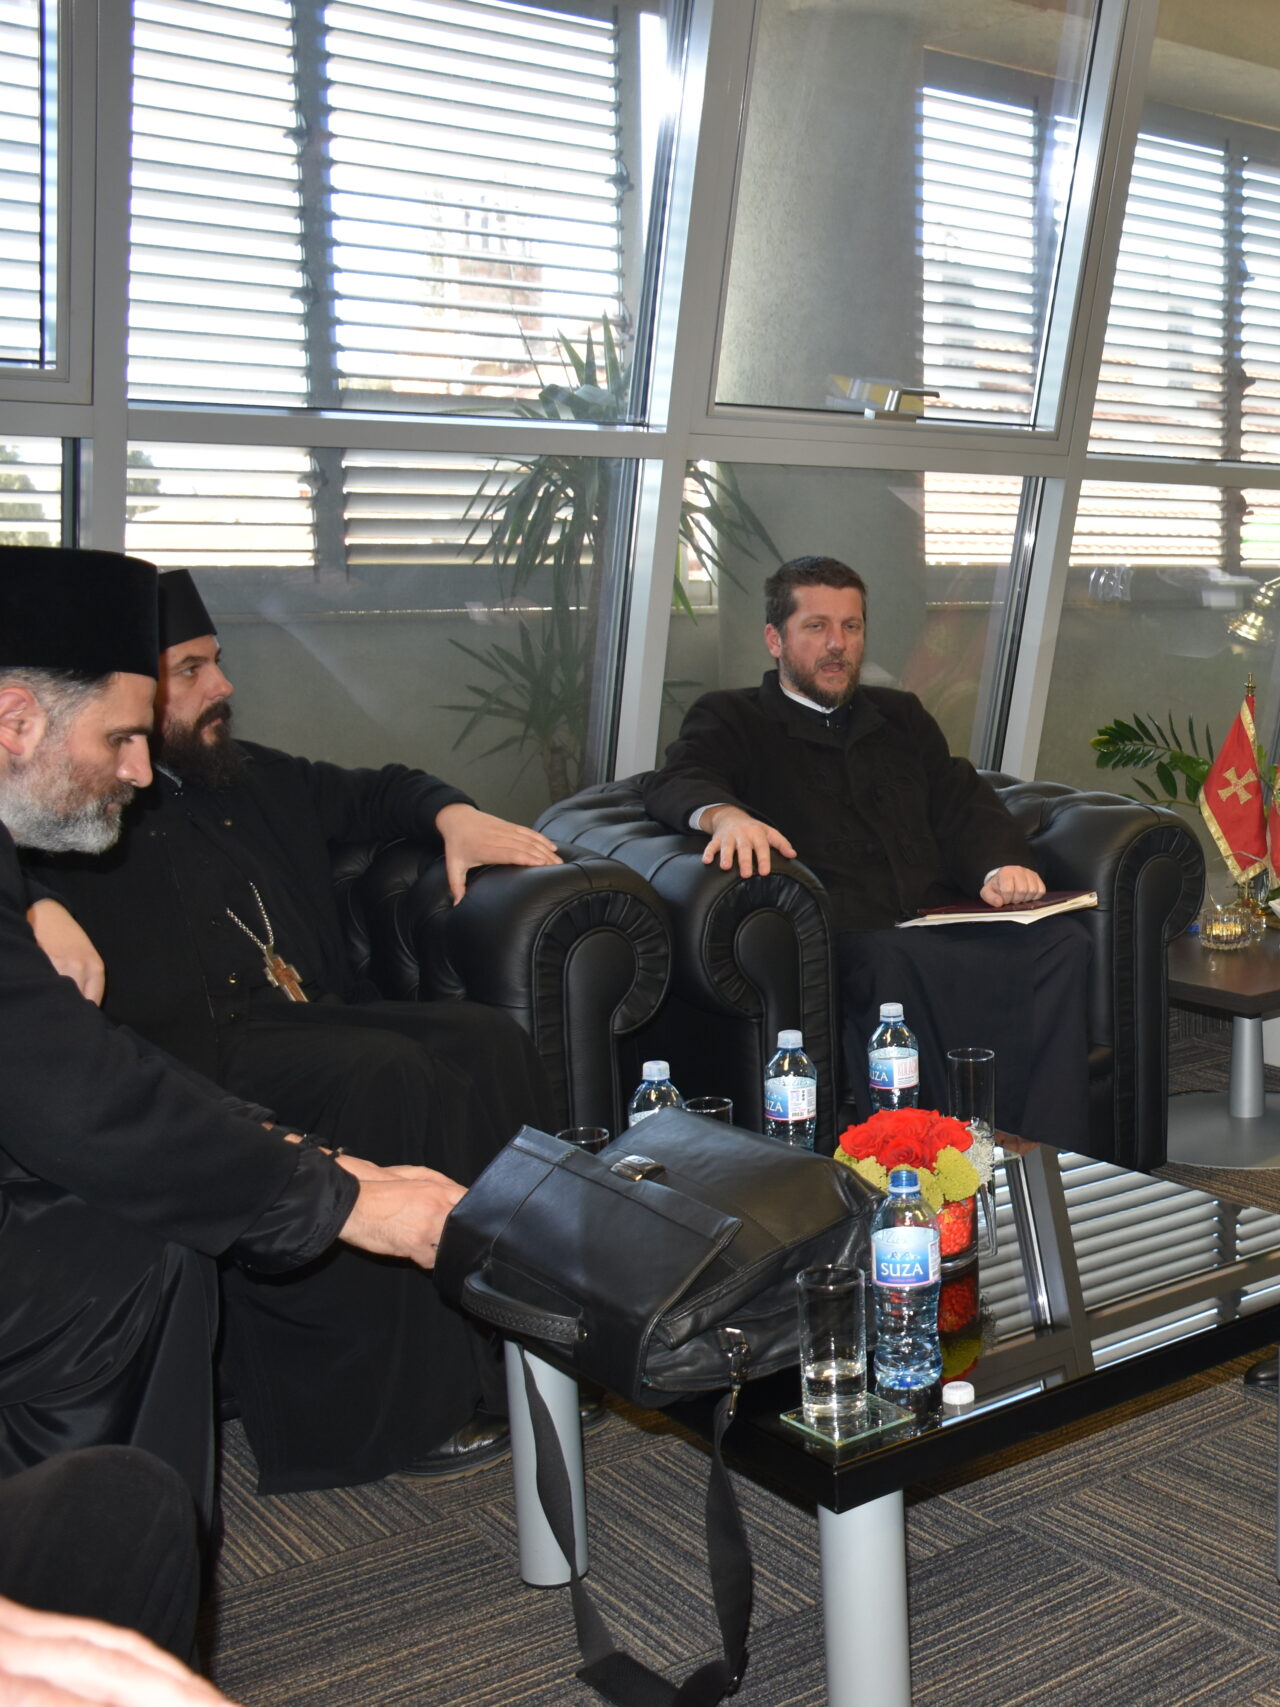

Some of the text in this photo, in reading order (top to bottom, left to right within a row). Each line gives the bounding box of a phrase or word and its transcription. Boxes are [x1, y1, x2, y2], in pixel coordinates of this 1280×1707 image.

[870, 1070, 889, 1082] UZA
[765, 1099, 783, 1113] UZA
[880, 1262, 924, 1277] SUZA
